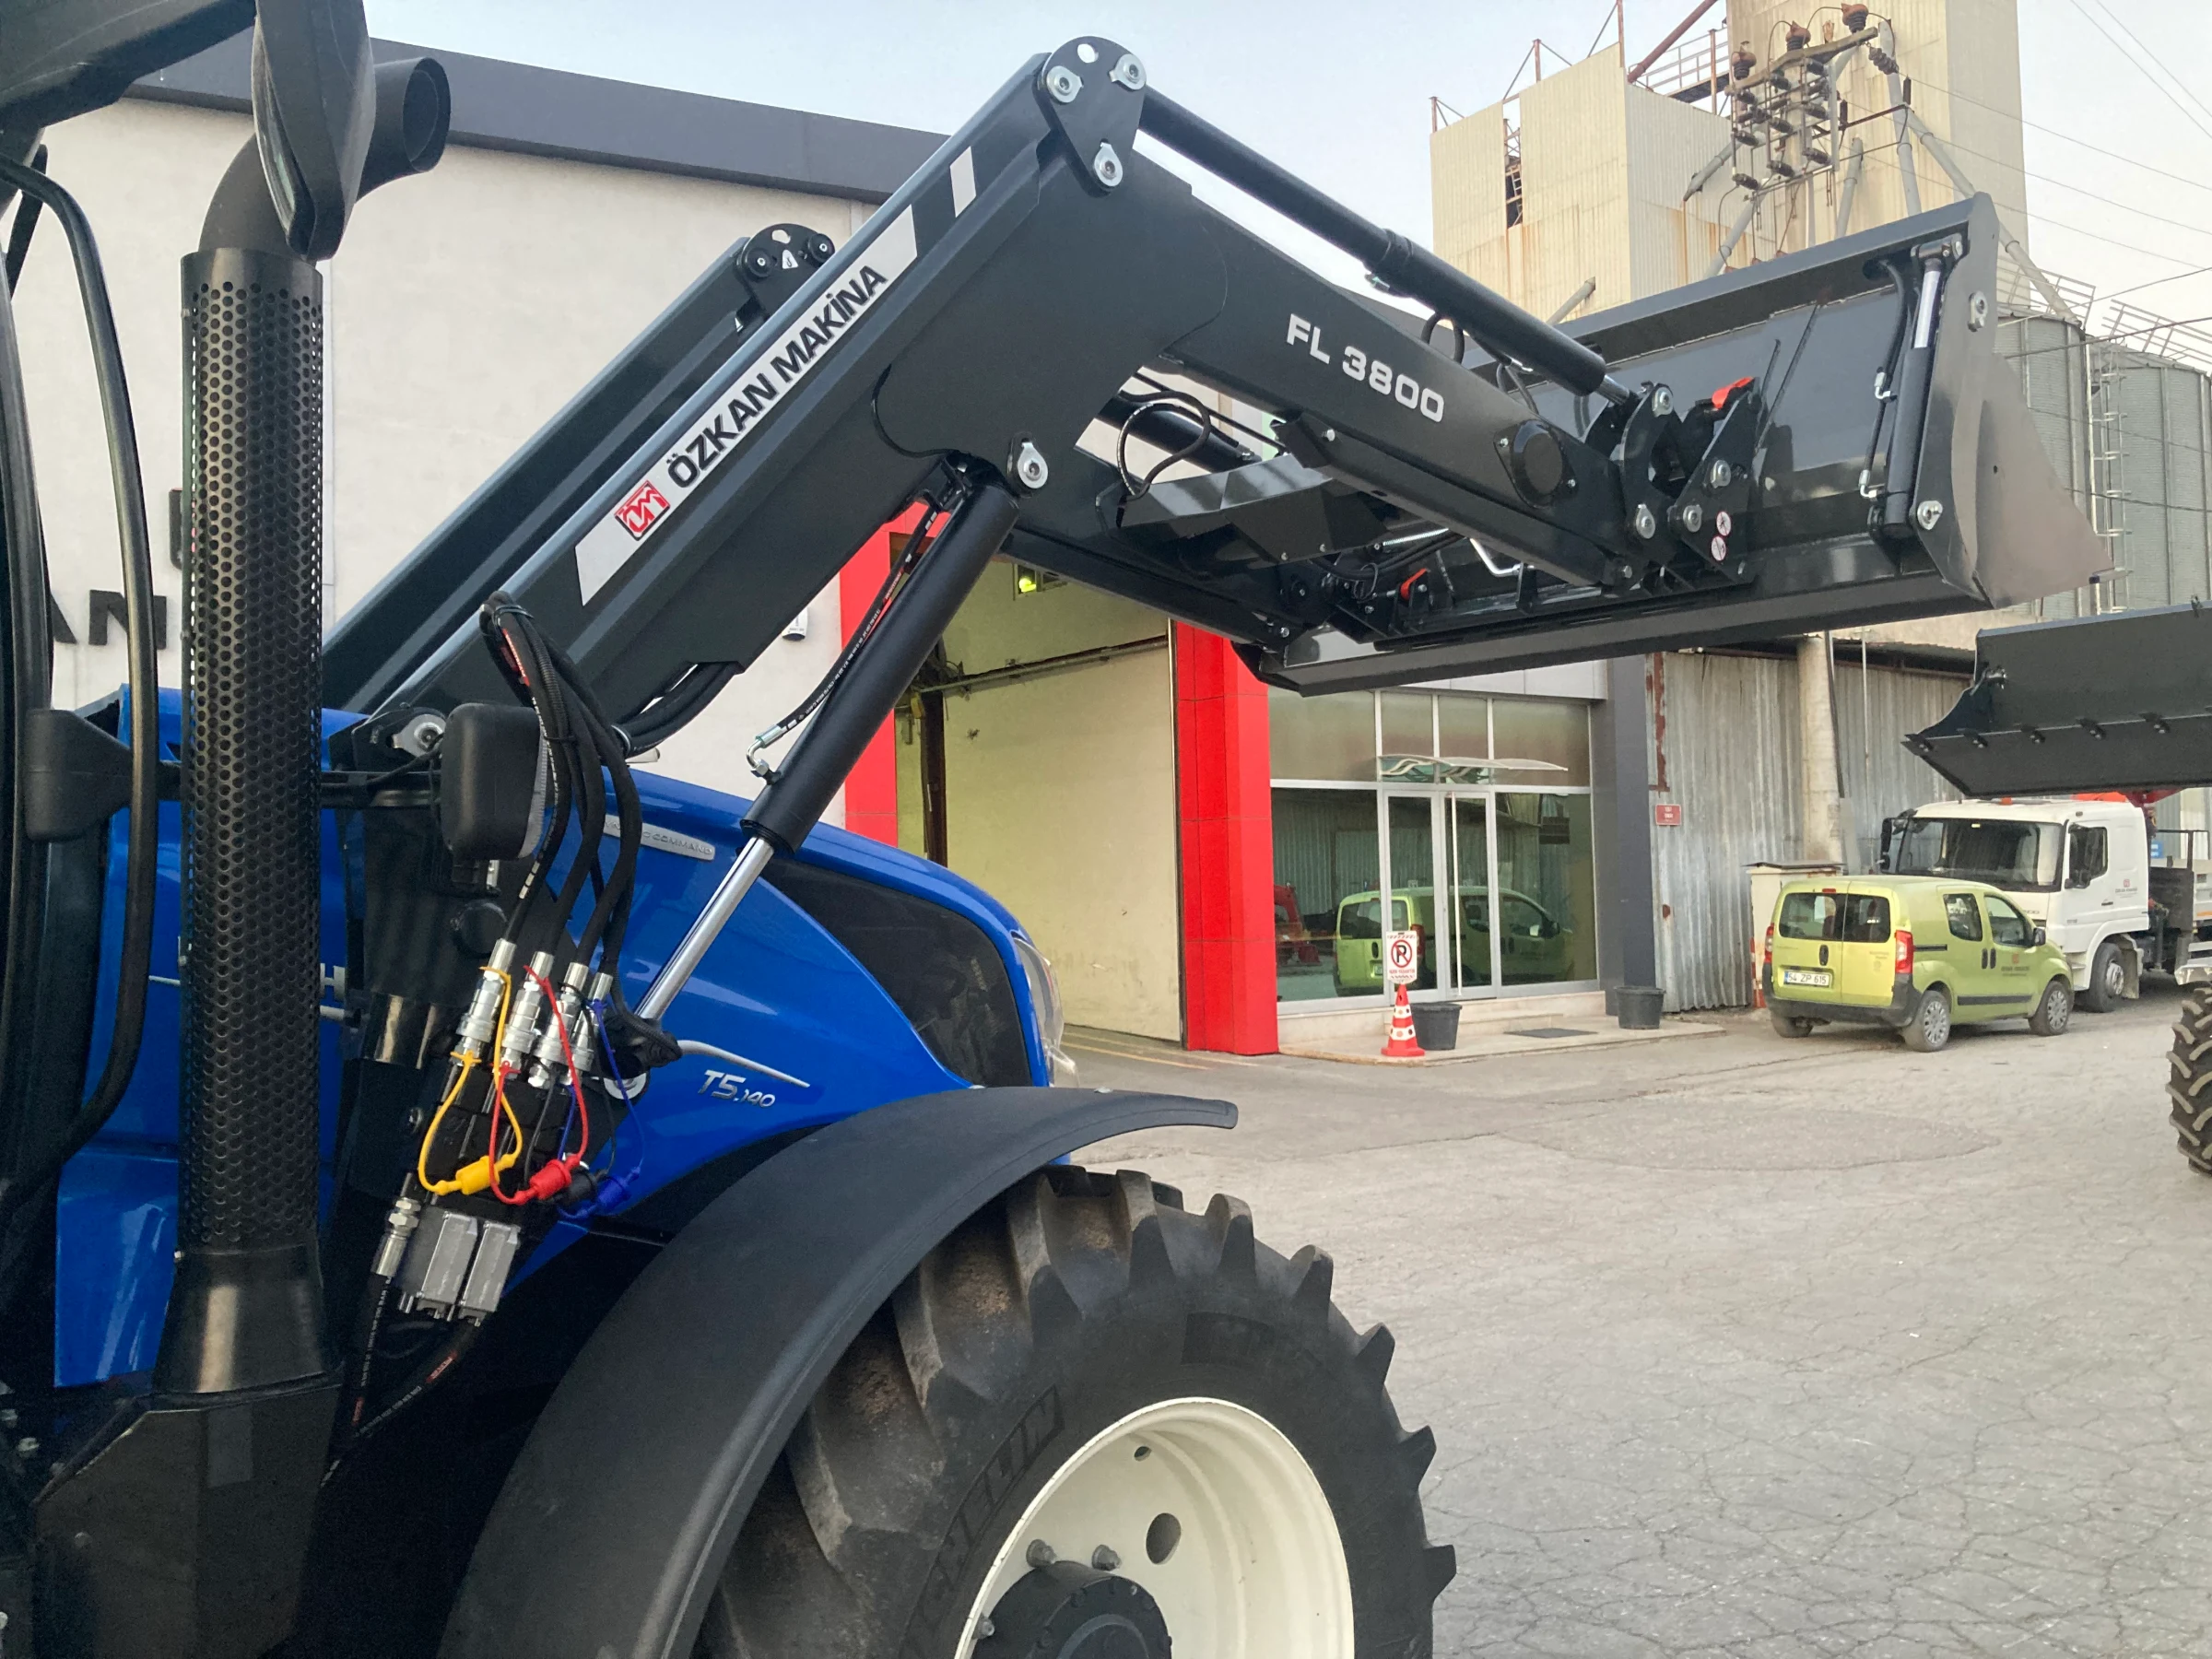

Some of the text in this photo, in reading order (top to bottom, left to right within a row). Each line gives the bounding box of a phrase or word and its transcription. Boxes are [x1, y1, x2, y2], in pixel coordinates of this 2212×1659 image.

[666, 265, 888, 488] ÖZKAN MAKİNA
[1287, 313, 1445, 423] FL 3800
[653, 832, 712, 855] COMMAND
[1800, 973, 1812, 982] ZP
[1814, 975, 1827, 984] 615
